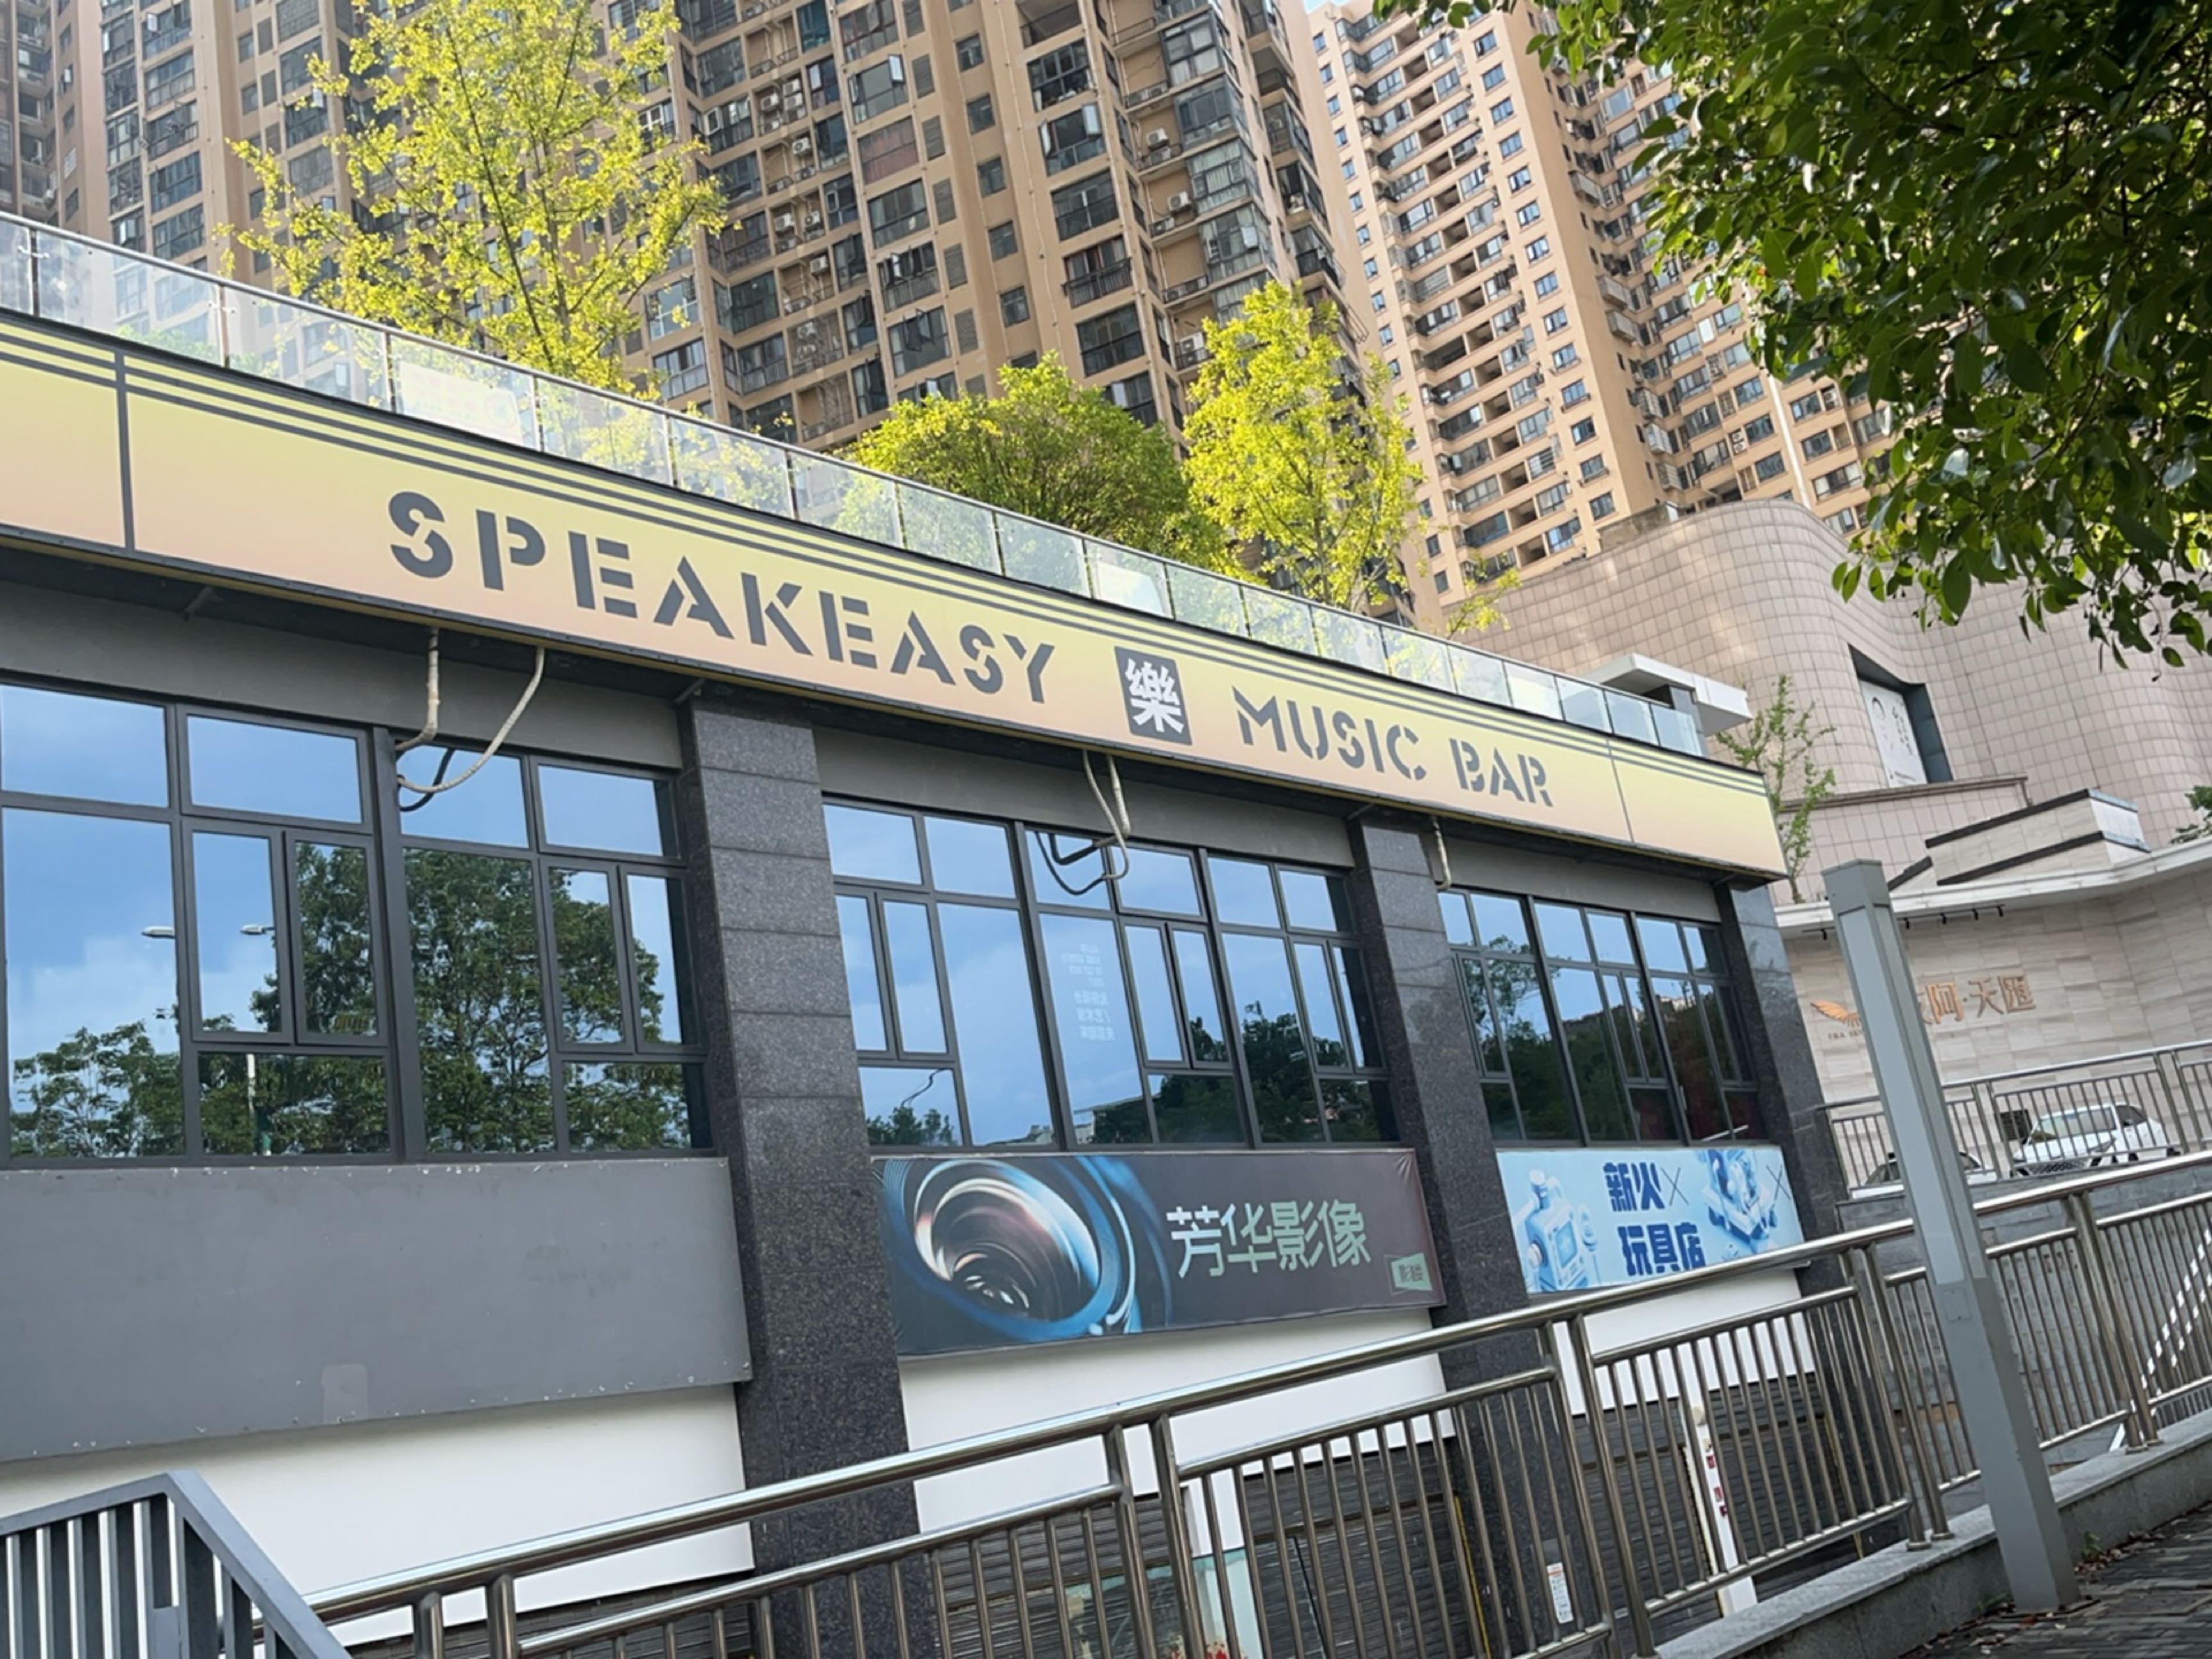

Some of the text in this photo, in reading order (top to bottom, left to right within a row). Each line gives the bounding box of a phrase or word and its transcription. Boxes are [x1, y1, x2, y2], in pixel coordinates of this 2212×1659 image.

[387, 490, 1055, 703] SPEAKEASY
[1124, 658, 1185, 734] 樂
[1231, 685, 1553, 807] MUSIC BAR
[1603, 1162, 1665, 1212] 新火
[1166, 1198, 1371, 1278] 芳华影像
[1617, 1221, 1706, 1277] 玩具店
